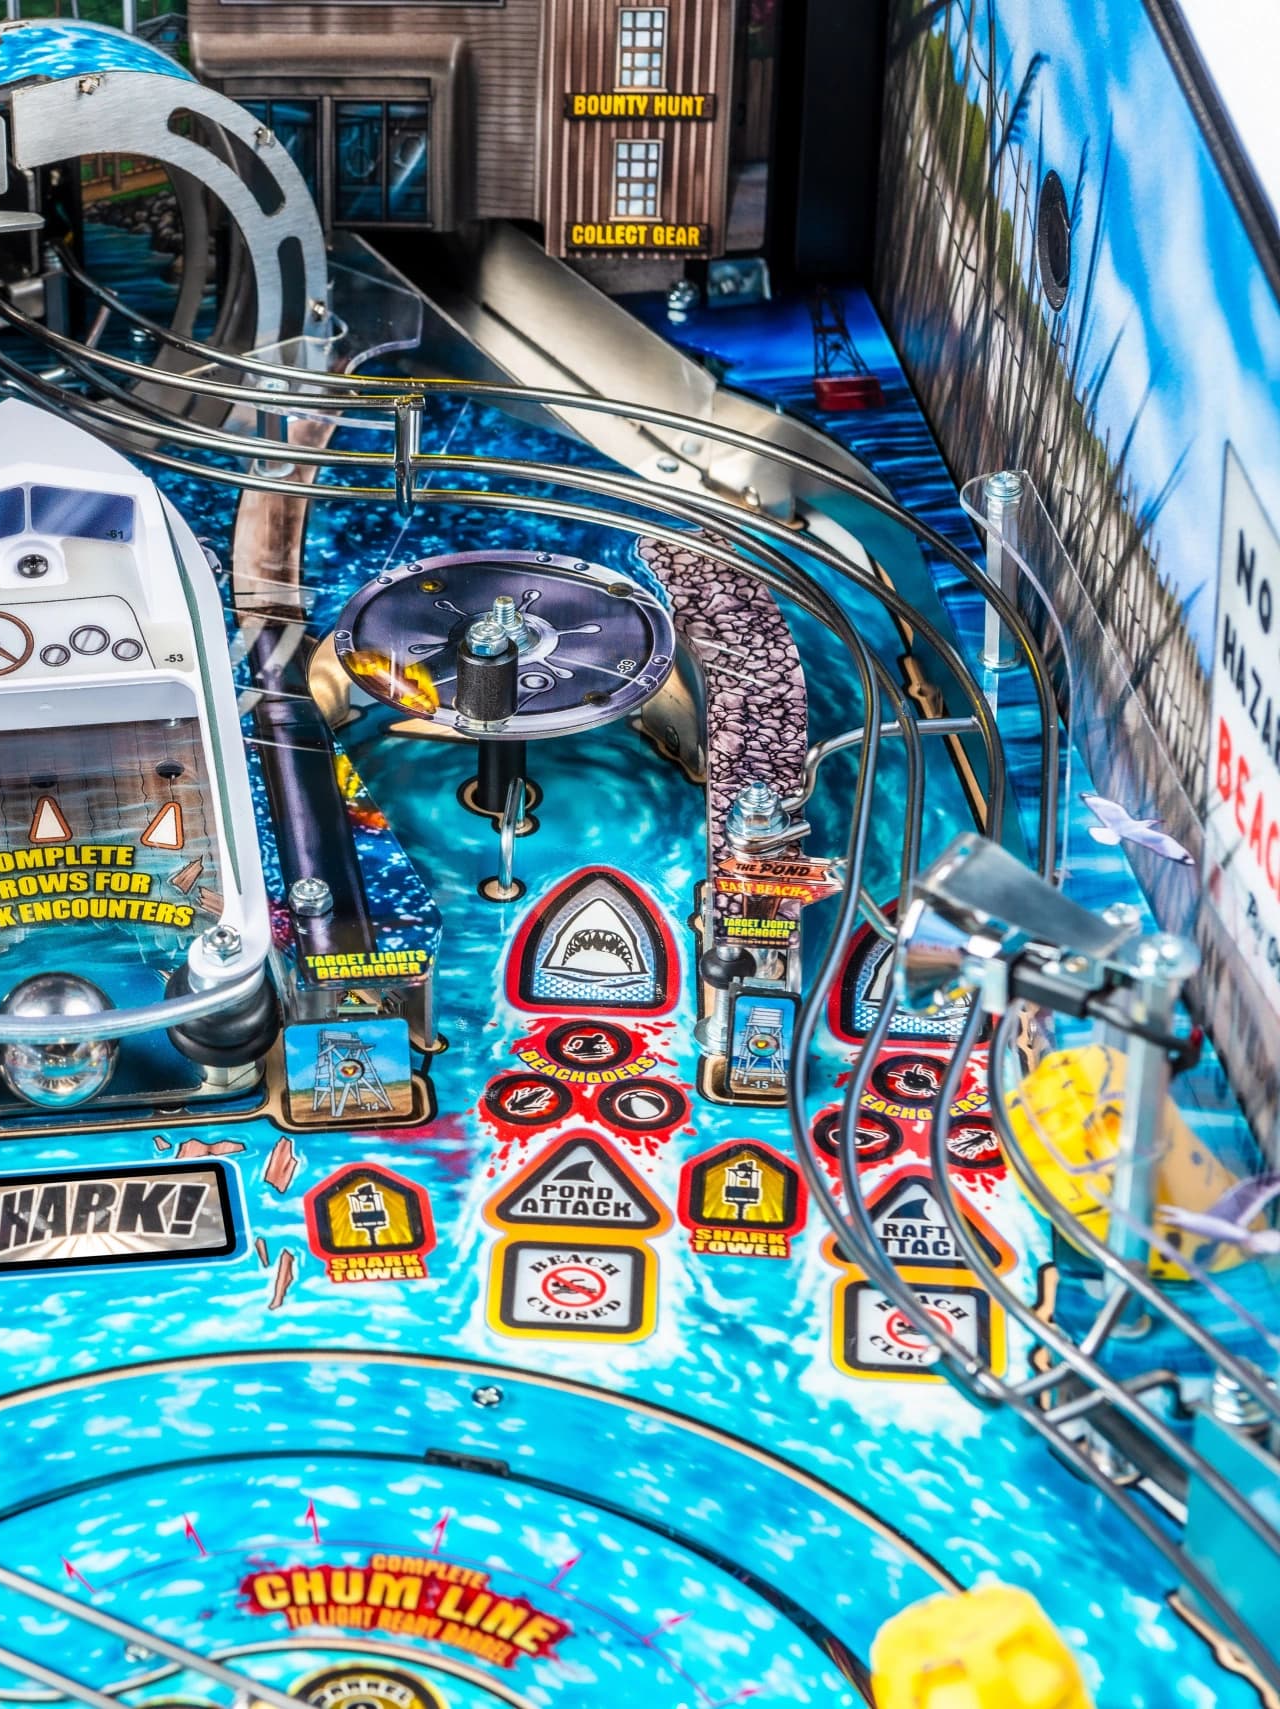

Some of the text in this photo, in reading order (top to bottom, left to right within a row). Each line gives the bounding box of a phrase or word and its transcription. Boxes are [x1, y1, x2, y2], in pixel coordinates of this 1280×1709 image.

[573, 95, 705, 117] BOUNTY HUNT
[572, 224, 701, 247] COLLECT GEAR
[1236, 528, 1272, 635] NO
[164, 653, 185, 663] -53
[1223, 614, 1280, 776] HAZA
[734, 862, 811, 878] THE POND
[95, 872, 152, 894] FOR
[720, 880, 802, 897] EAST BEACH
[19, 899, 195, 928] ENCOUNTERS
[723, 917, 796, 930] TARGET LIGHTS
[727, 926, 790, 938] BEACHGOER
[306, 950, 428, 969] TARGET LIGHTS
[316, 962, 421, 980] BEACHGOER
[519, 1049, 658, 1085] BEACHGOERS
[750, 1080, 770, 1090] -15
[360, 1102, 380, 1112] -14
[541, 1184, 614, 1201] POND
[520, 1198, 632, 1218] ATTACK
[695, 1228, 786, 1245] SHARK
[883, 1223, 949, 1240] RAFT
[693, 1240, 787, 1257] TOWER
[330, 1254, 420, 1270] SHARK
[528, 1253, 622, 1277] BEACH
[330, 1266, 424, 1282] TOWER
[526, 1295, 622, 1322] CLOSED
[371, 1553, 492, 1589] COMPLETE
[253, 1569, 560, 1654] CHUM LINE
